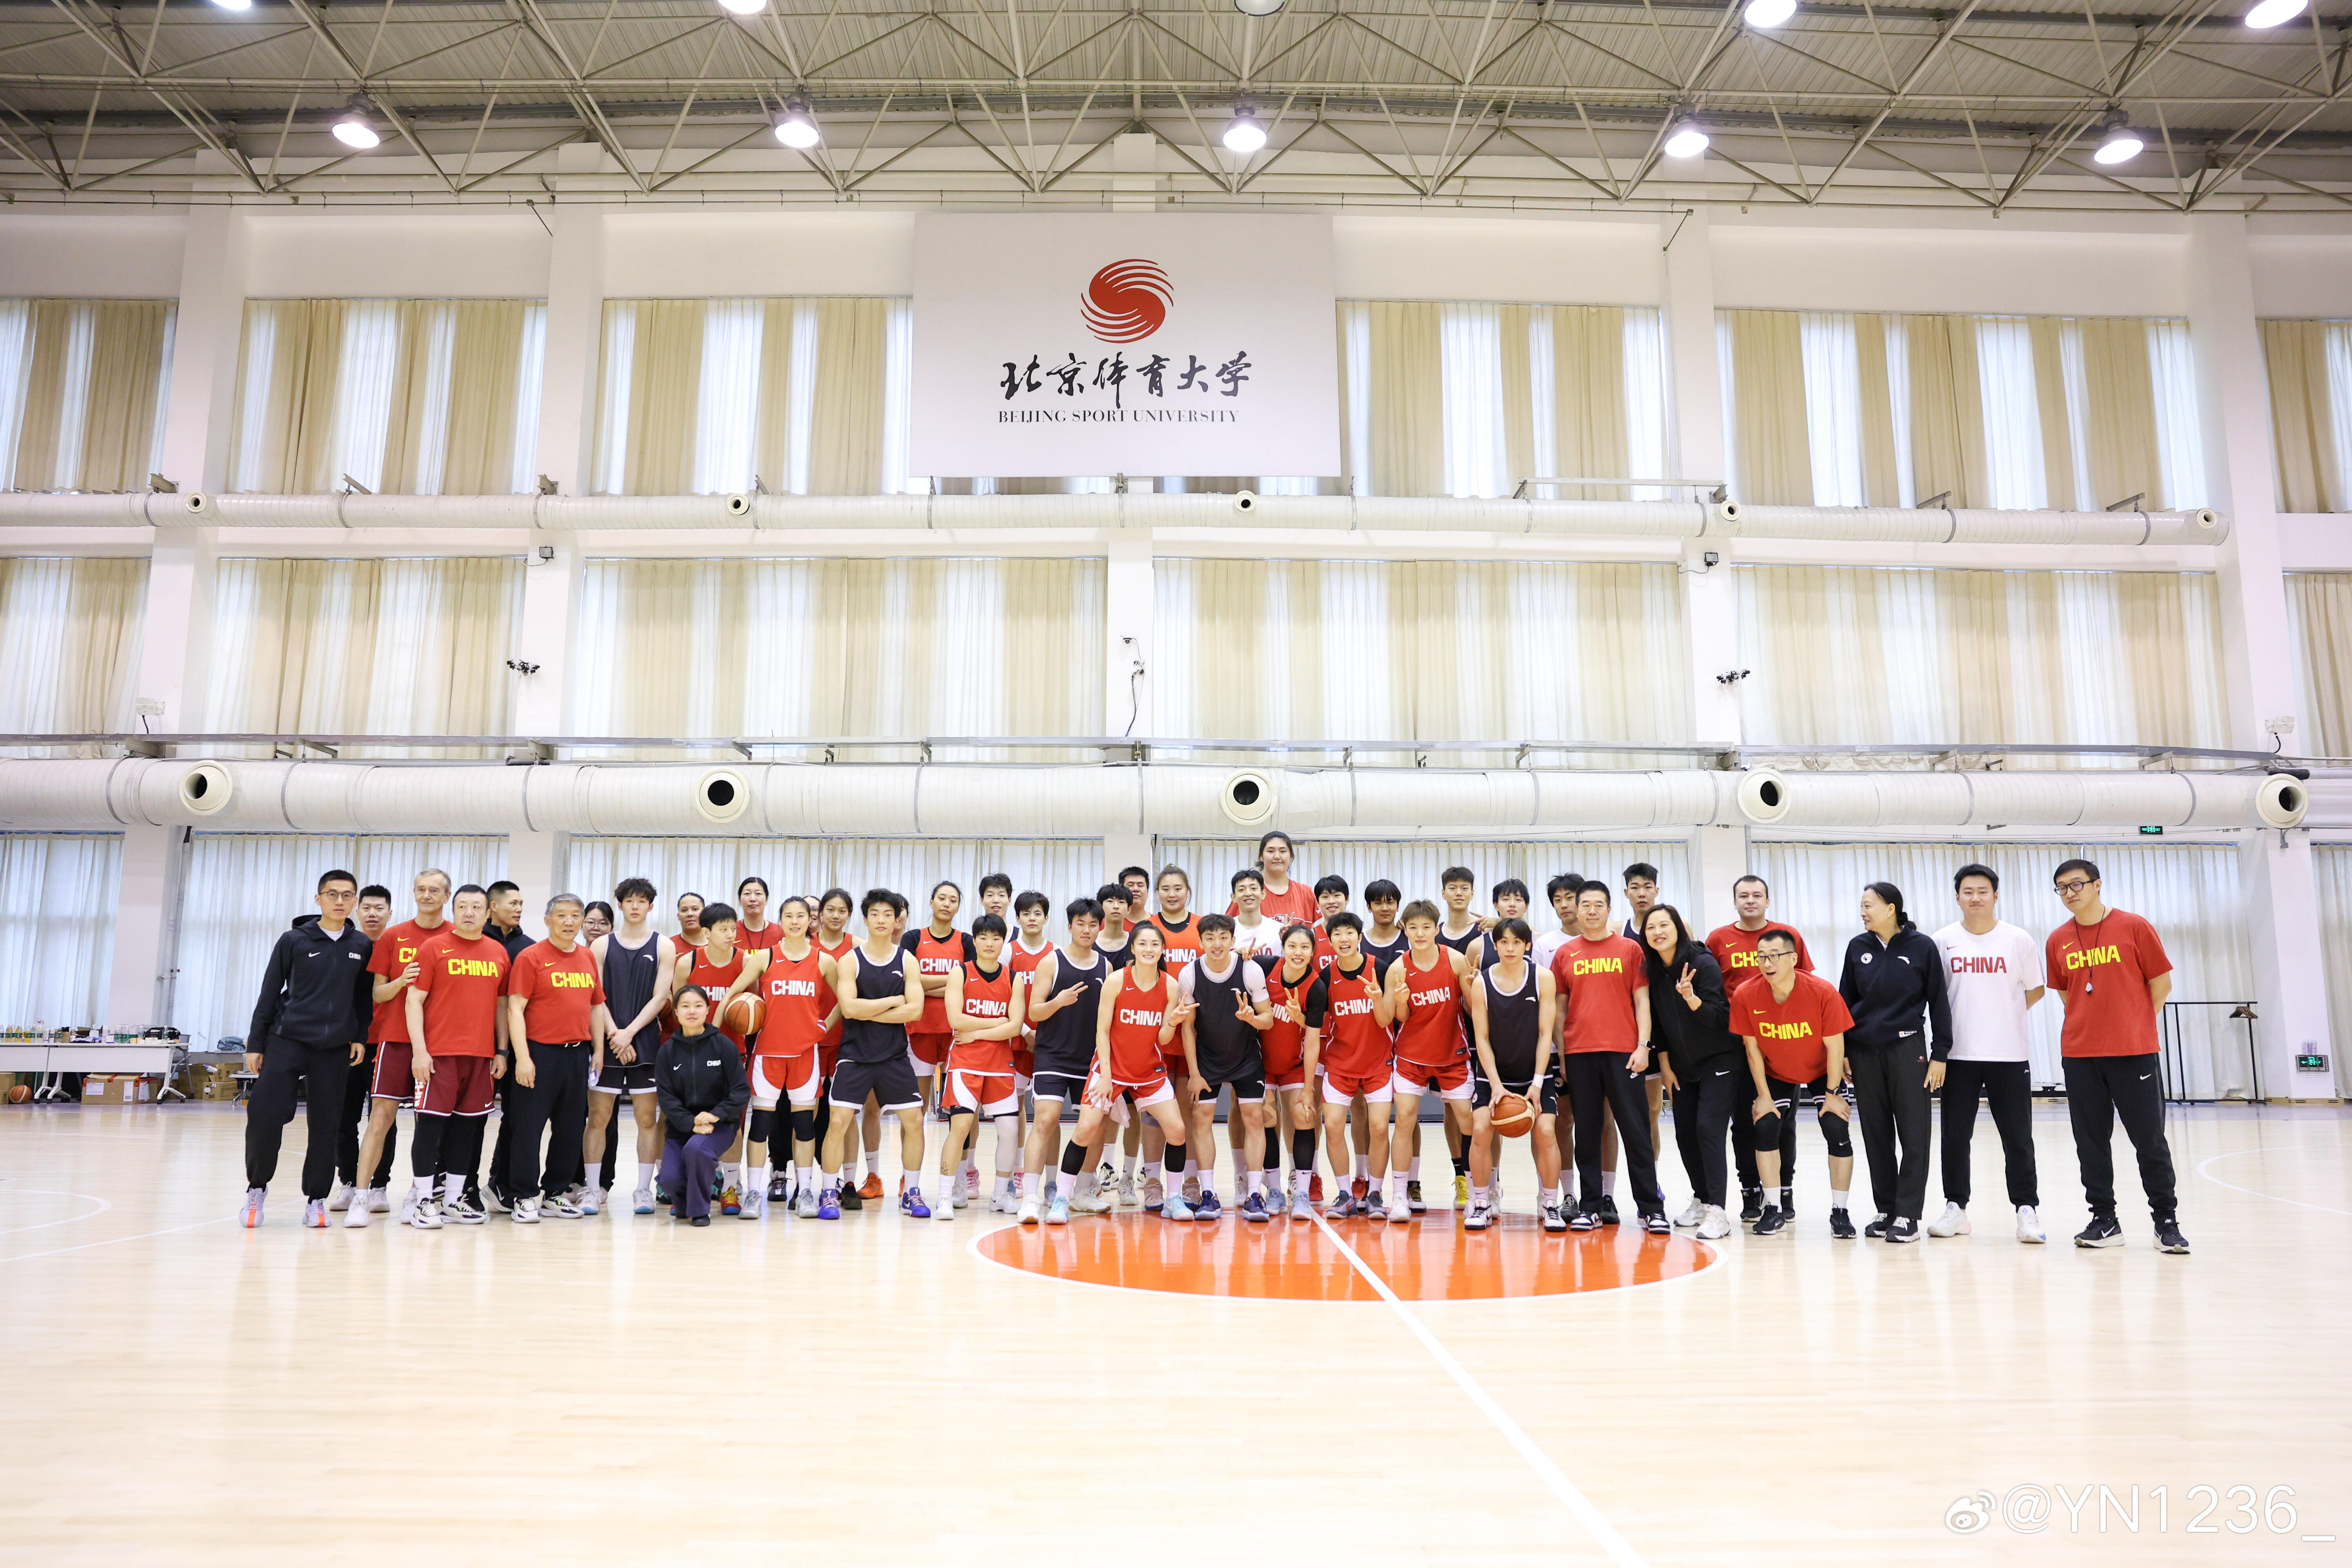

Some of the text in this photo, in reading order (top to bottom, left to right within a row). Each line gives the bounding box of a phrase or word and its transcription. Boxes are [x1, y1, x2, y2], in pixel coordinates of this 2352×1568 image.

[1000, 351, 1252, 409] 北京体育大学
[998, 410, 1239, 423] BEIJING SPORT UNIVERSITY
[1163, 949, 1196, 962] HINA
[1731, 951, 1759, 968] CHI
[2066, 945, 2121, 970] CHINA
[448, 959, 498, 978] CHINA
[1573, 957, 1623, 976] CHINA
[1951, 957, 2007, 973] CHINA
[551, 972, 595, 988] CHINA
[771, 980, 815, 997] CHINA
[701, 986, 730, 1001] HIN
[1411, 987, 1450, 1006] CHINA
[966, 998, 1007, 1016] CHINA
[1334, 998, 1374, 1016] CHINA
[1120, 1008, 1161, 1026] CHINA
[1759, 1022, 1813, 1040] CHINA
